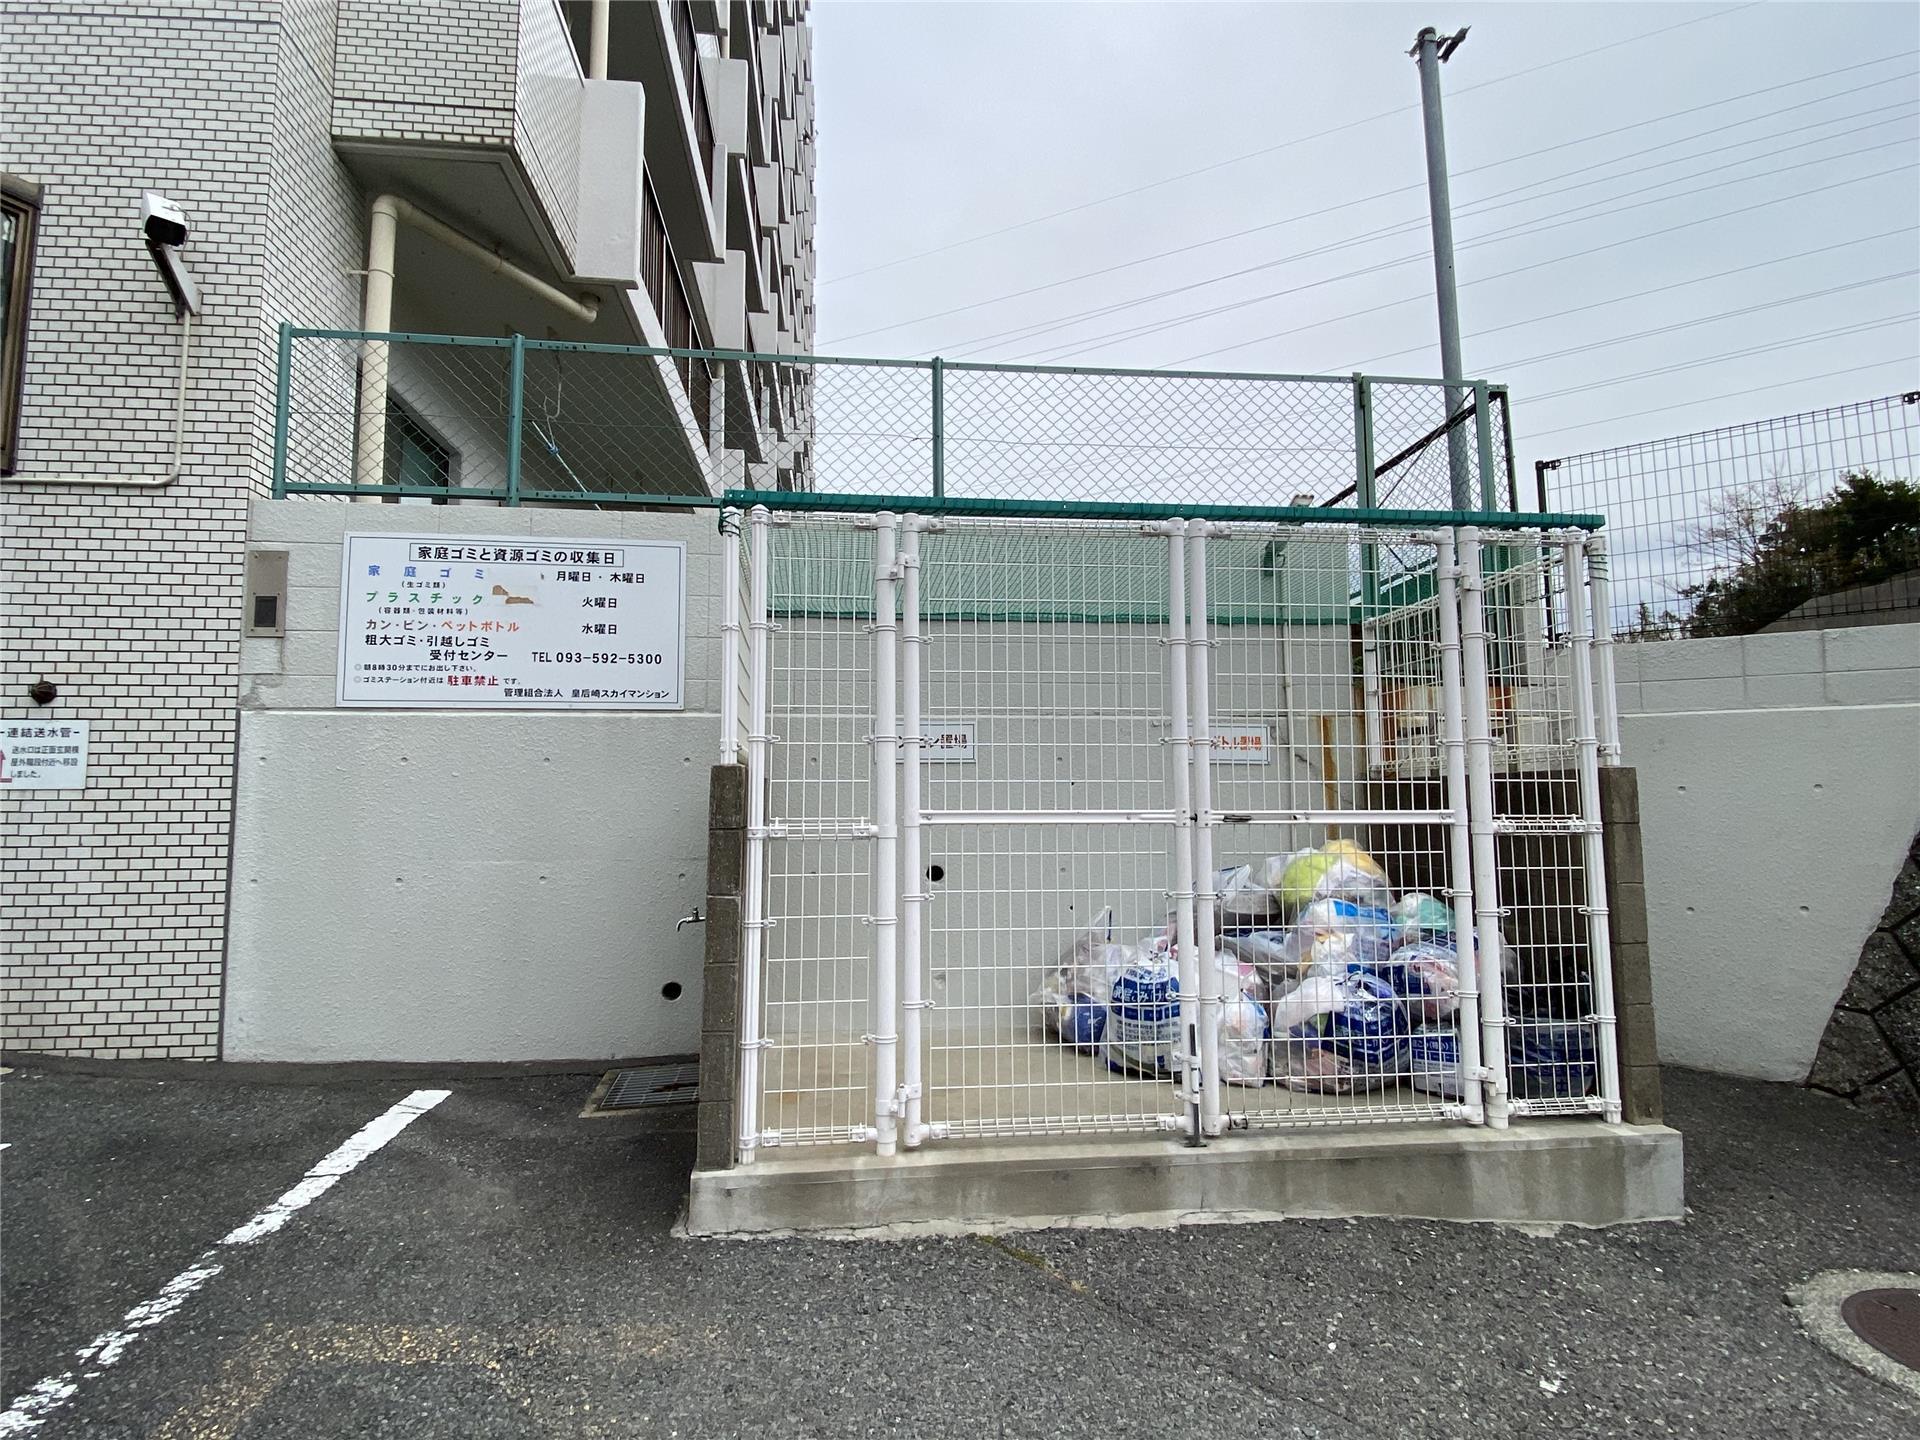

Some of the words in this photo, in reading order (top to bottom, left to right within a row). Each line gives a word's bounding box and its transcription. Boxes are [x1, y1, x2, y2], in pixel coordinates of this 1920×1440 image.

[418, 546, 615, 565] 家庭ゴミと資源ゴミの収集日
[368, 564, 485, 579] 家庭ゴミ
[366, 591, 483, 605] プラスチック
[581, 597, 618, 608] 火曜日
[581, 623, 618, 635] 水曜日
[364, 634, 490, 648] 粗大ゴミ・引越しゴミ
[429, 649, 508, 661] 受付センター
[532, 651, 552, 663] TEL
[556, 652, 662, 665] 093-592-5300
[447, 675, 499, 686] 駐車禁止
[504, 688, 563, 698] 管理組合法人
